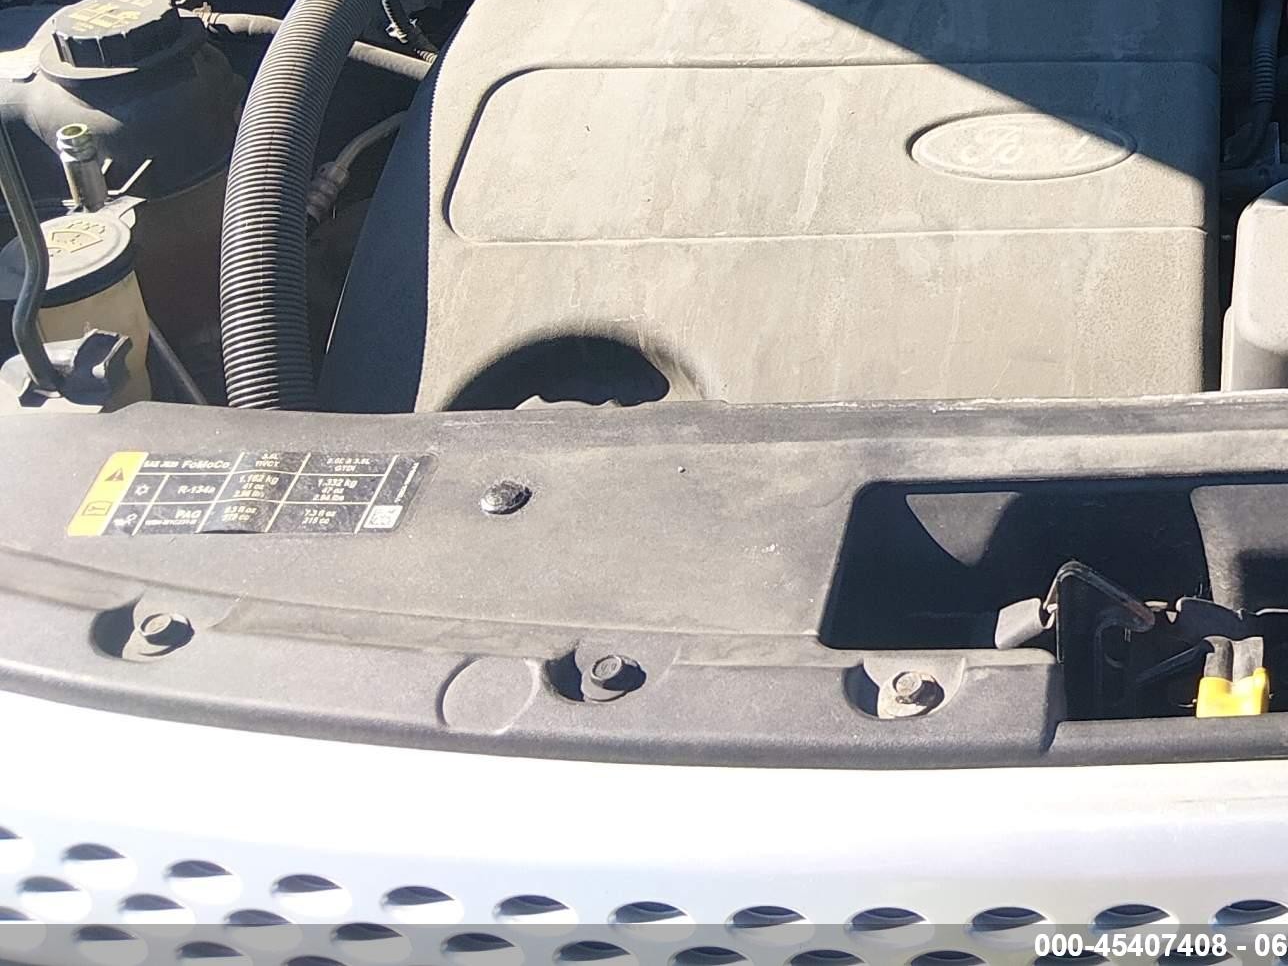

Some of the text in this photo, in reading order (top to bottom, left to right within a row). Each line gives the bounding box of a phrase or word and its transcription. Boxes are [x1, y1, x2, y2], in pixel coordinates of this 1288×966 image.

[959, 124, 1092, 165] Ford
[181, 459, 231, 469] FoMoCo
[265, 475, 280, 485] kg
[344, 479, 358, 488] kg
[177, 485, 216, 494] R-134a
